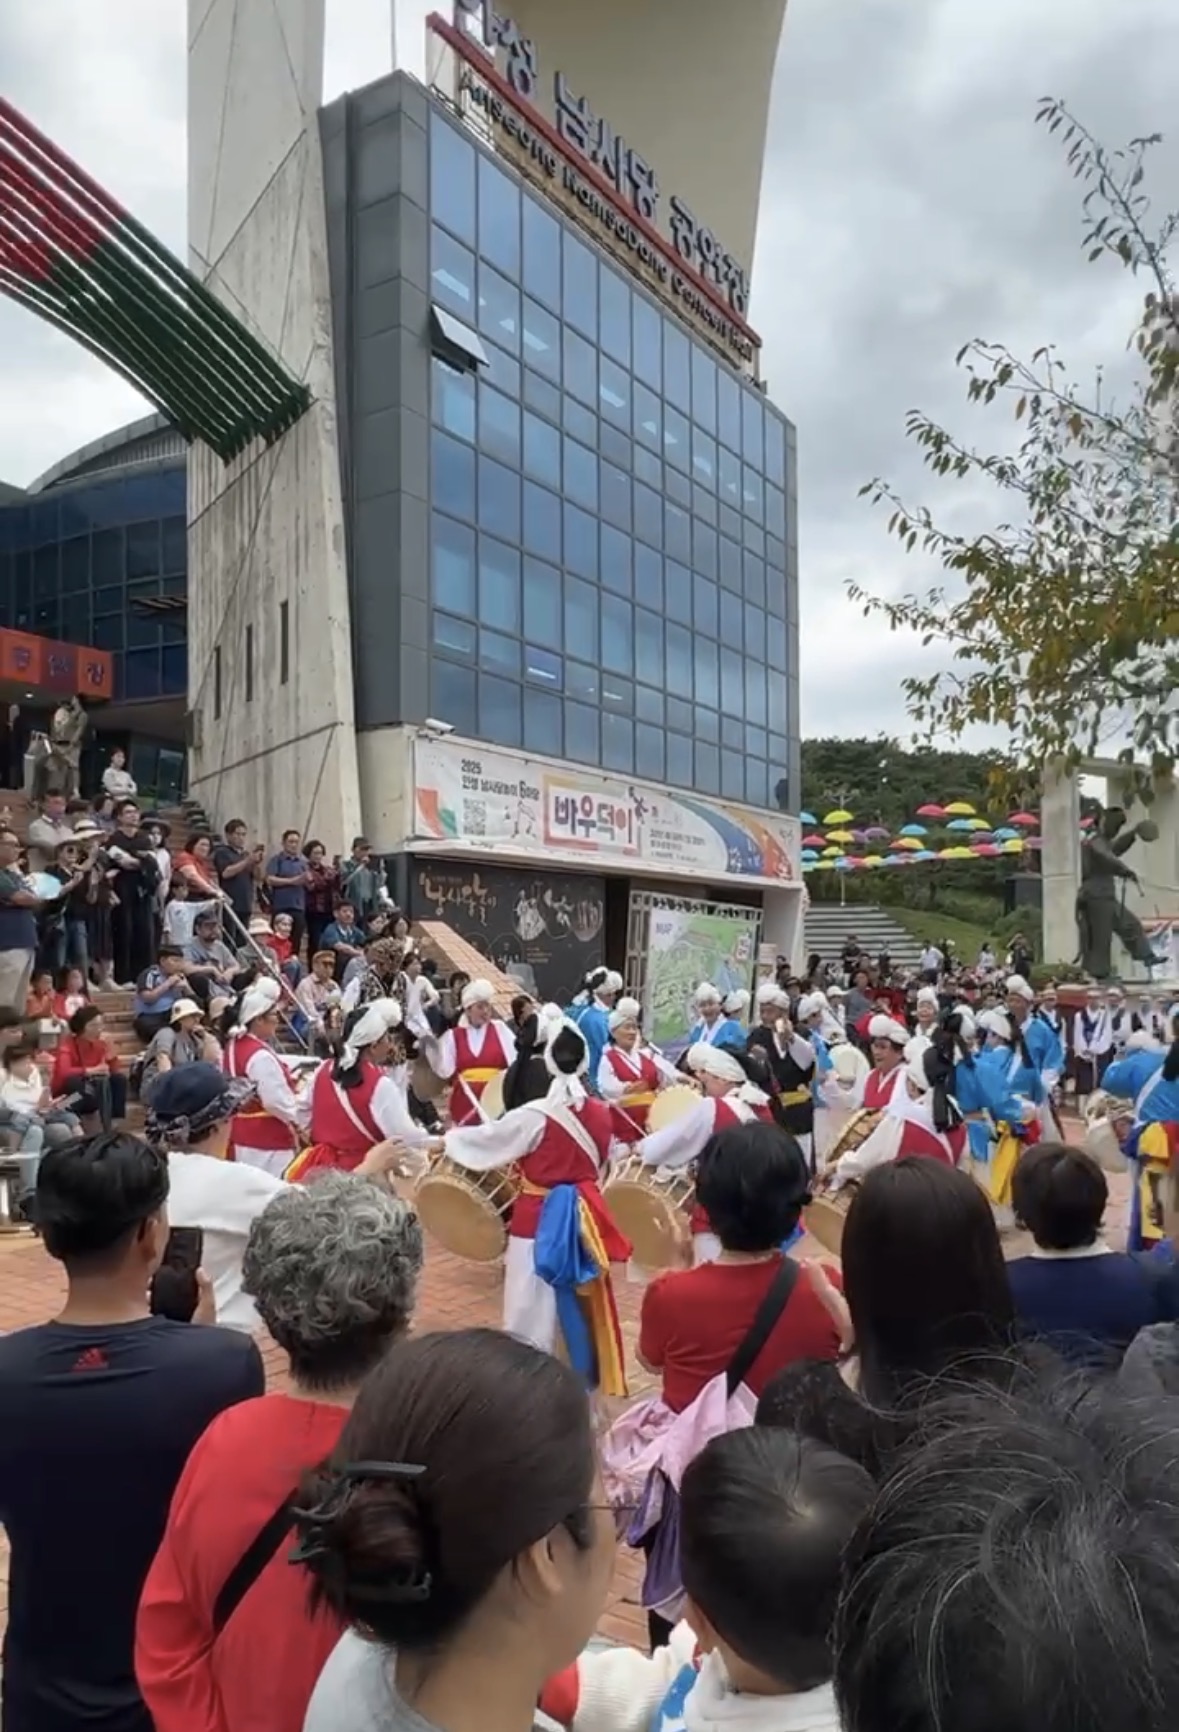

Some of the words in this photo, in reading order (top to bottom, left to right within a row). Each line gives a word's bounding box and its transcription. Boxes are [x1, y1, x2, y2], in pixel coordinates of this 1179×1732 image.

[554, 70, 659, 222] 남사당
[670, 195, 750, 316] 공연장
[461, 759, 482, 775] 2025
[462, 775, 479, 791] 안성
[554, 794, 633, 845] 바우덕이
